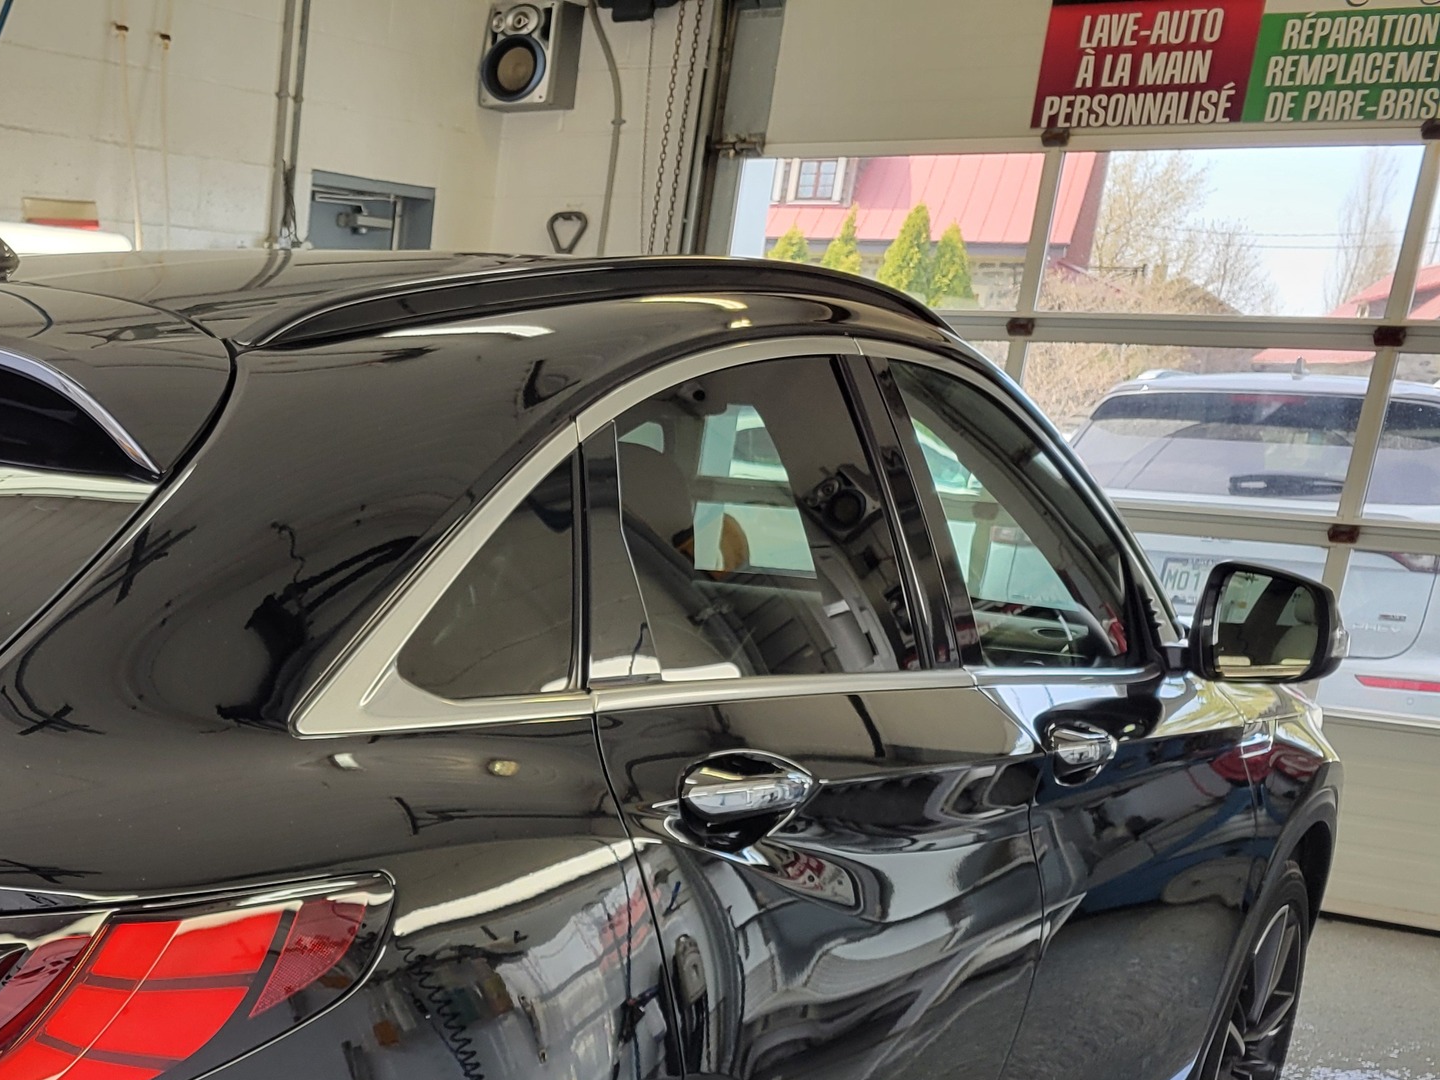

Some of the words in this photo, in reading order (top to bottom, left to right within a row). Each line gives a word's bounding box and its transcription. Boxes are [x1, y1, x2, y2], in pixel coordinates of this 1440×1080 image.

[1079, 7, 1225, 48] LAVE-AUTO
[1281, 11, 1440, 50] RÉPARATION
[1075, 48, 1096, 88] À
[1100, 53, 1133, 88] LA
[1137, 49, 1213, 86] MAIN
[1040, 81, 1236, 129] PERSONNALISÉ
[1263, 91, 1299, 123] DE
[1301, 87, 1440, 121] PARE-BRIS
